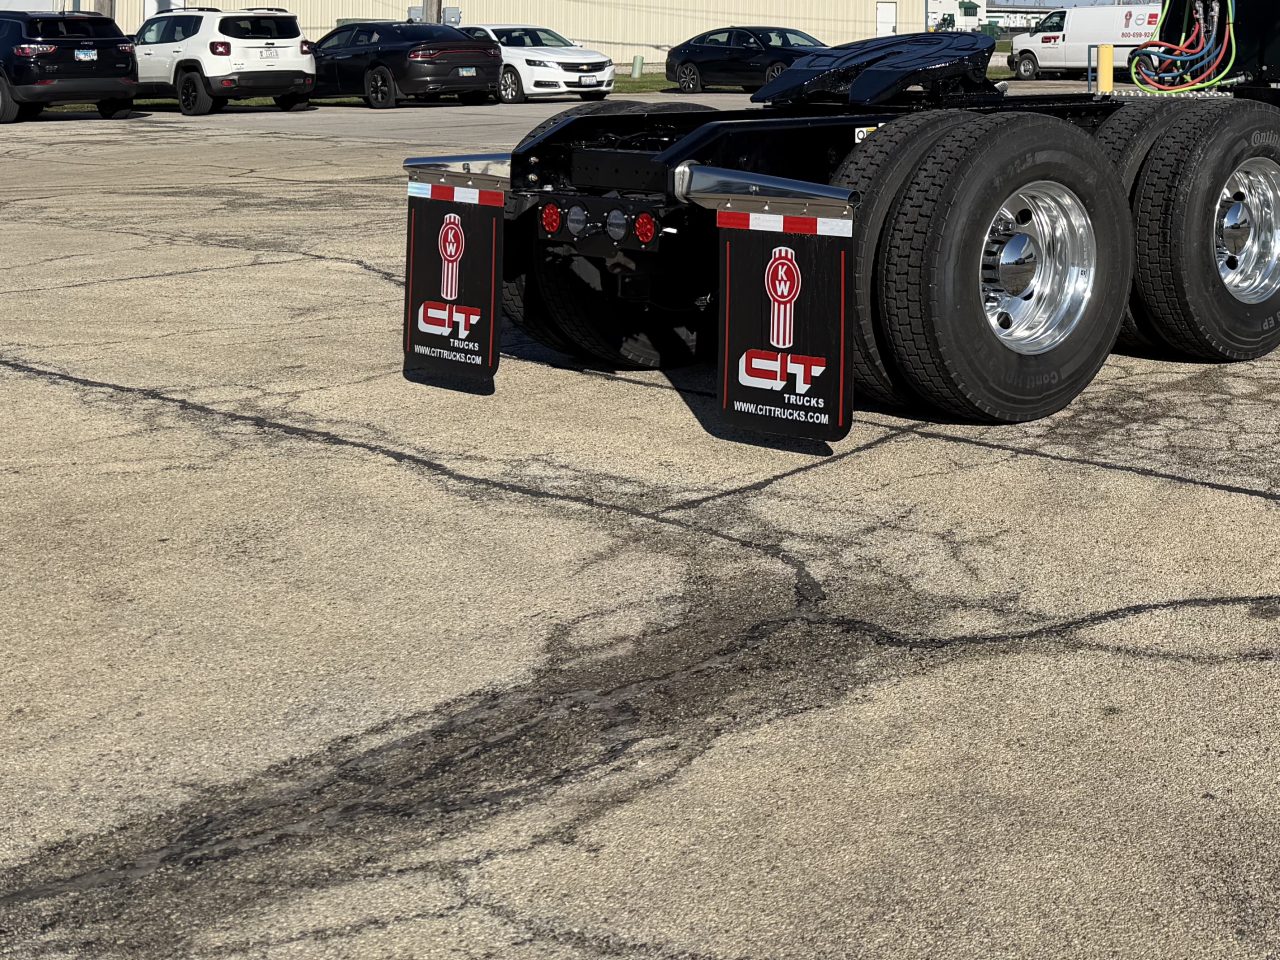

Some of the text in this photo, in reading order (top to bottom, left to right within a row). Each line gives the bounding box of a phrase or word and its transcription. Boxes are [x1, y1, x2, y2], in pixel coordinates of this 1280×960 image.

[418, 301, 481, 339] CIT
[414, 344, 482, 365] WWW.CITTRUCKS.COM
[450, 339, 479, 351] TRUCKS
[739, 349, 826, 394] CIT
[784, 394, 824, 408] TRUCKS
[734, 401, 829, 425] WWW.CITTRUCKS.COM
